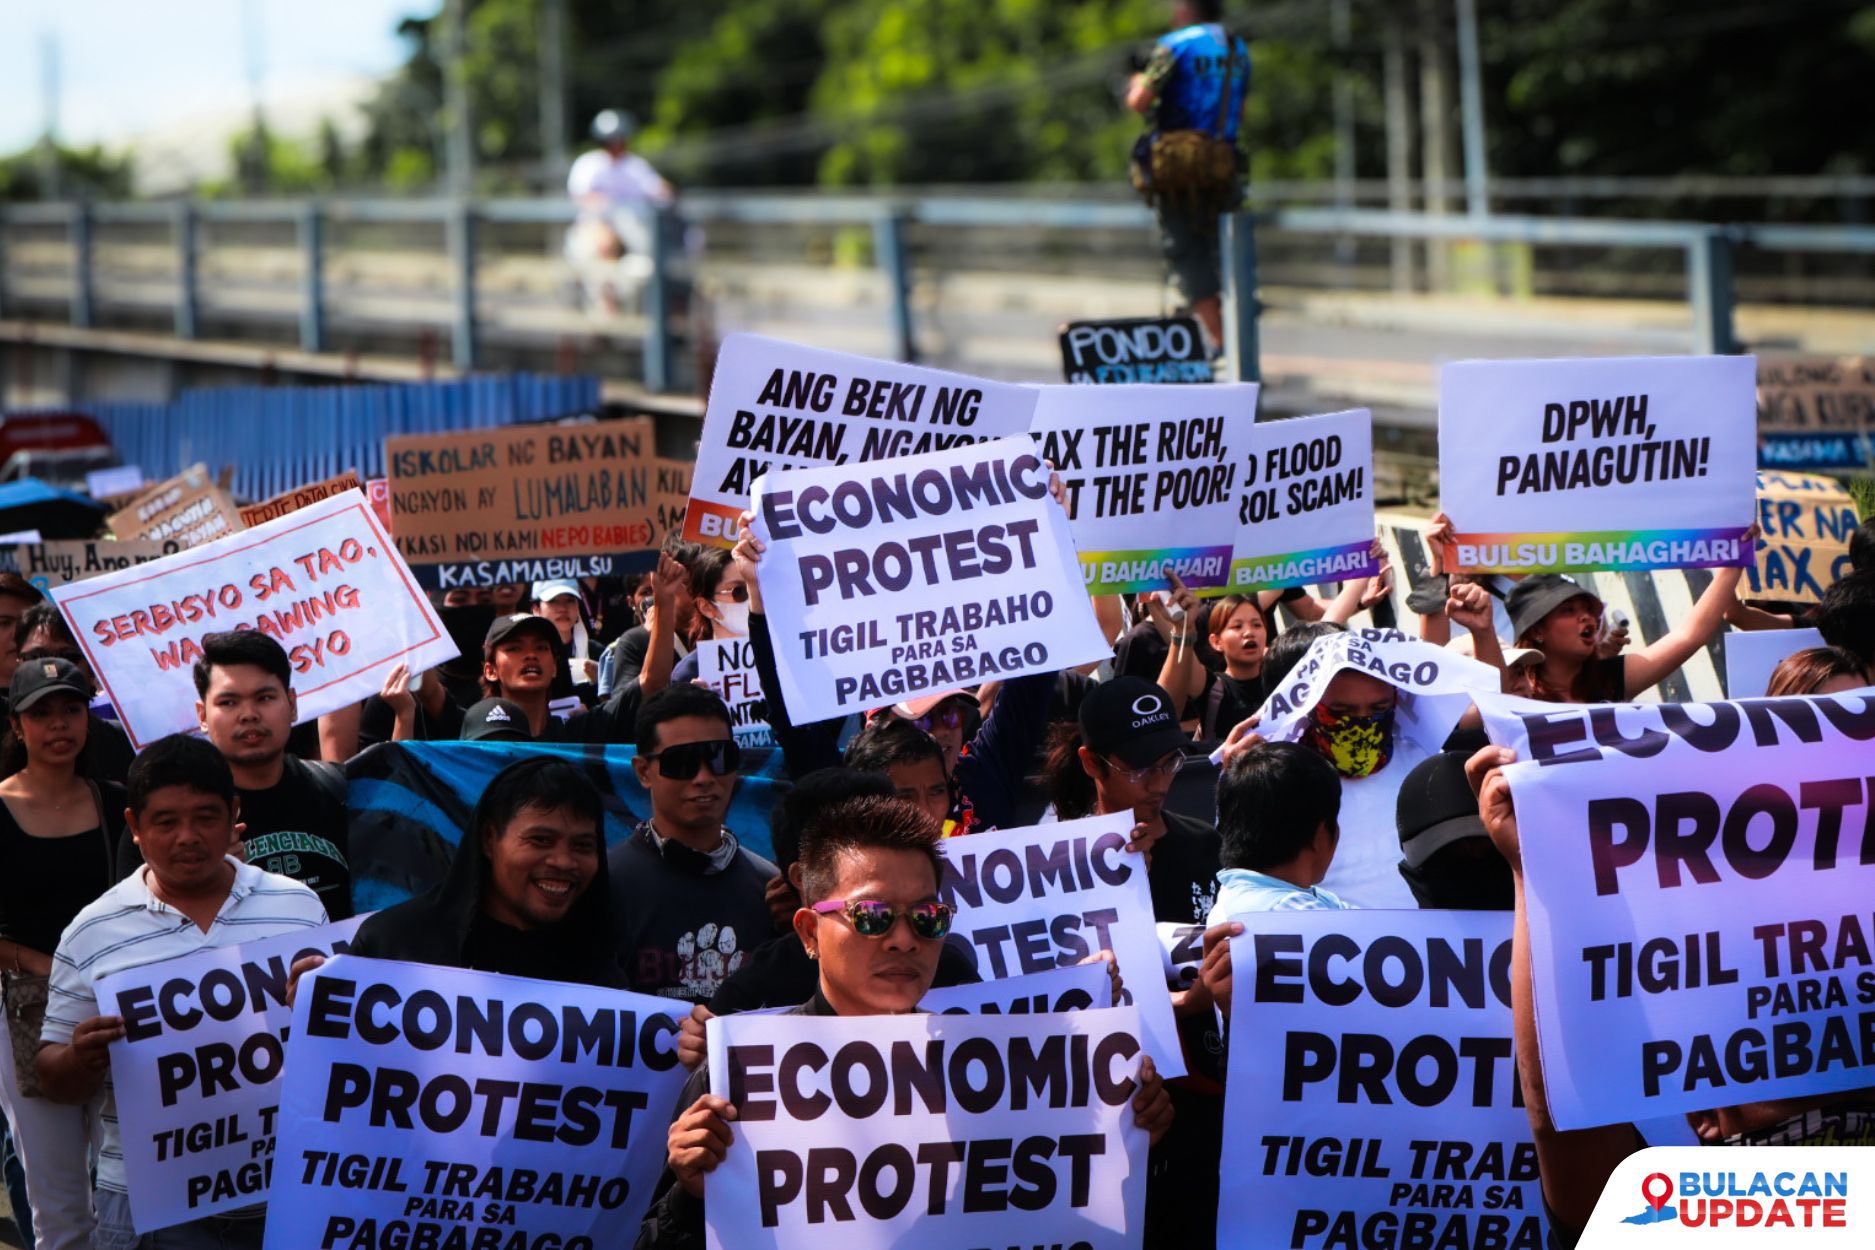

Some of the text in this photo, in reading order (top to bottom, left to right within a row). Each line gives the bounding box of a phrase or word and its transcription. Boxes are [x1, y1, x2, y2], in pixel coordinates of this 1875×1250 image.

[1068, 324, 1192, 367] PONDO
[757, 368, 983, 427] ANG BEKI NG
[1542, 395, 1656, 440] DPWH,
[393, 444, 497, 479] ISKOLAR
[547, 432, 641, 464] BAYAN
[726, 410, 1000, 467] BAYAN, NGAY
[1093, 422, 1150, 468] THE
[1156, 416, 1228, 463] RICH,
[1265, 435, 1343, 483] FLOOD
[1093, 472, 1149, 518] THE
[1153, 462, 1237, 513] POOR!
[1286, 466, 1364, 515] SCAM!
[1496, 437, 1710, 496] PANAGUTIN!
[393, 487, 467, 515] NGAYON
[477, 487, 497, 510] AY
[513, 466, 647, 521] LUMALABAN
[761, 454, 1047, 541] ECONOMIC
[456, 531, 488, 553] NDI
[494, 530, 538, 551] KAMI
[541, 527, 589, 549] NEPO
[798, 518, 1039, 606] PROTEST
[1457, 539, 1739, 567] BULSU BAHAGHARI
[438, 556, 613, 590] KASAMABULSU
[1100, 555, 1224, 584] BAHAGHARI
[1235, 550, 1368, 586] BAHAGHARI
[93, 583, 243, 646] SERBISYO
[250, 566, 296, 600] SA
[799, 590, 1054, 660] TIGIL TRABAHO
[835, 641, 1048, 706] PAGBABAGO
[891, 633, 978, 664] PARA SA
[1132, 712, 1170, 728] OAKLEY
[938, 832, 1133, 909] NOMIC
[1582, 913, 1875, 1002] TIGIL TRA
[307, 975, 681, 1072] ECONOMIC
[1747, 975, 1849, 1020] PARA
[158, 1027, 291, 1107] PRO
[727, 1032, 1141, 1122] ECONOMIC
[1282, 1031, 1527, 1108] PROT
[323, 1062, 648, 1150] PROTEST
[153, 1113, 247, 1162] TIGIL
[1261, 1135, 1390, 1178] TIGIL
[188, 1159, 274, 1208] PAG
[302, 1150, 630, 1210] TIGIL TRABAHO
[756, 1133, 1106, 1228] PROTEST
[1389, 1183, 1524, 1210] PARA SA
[403, 1197, 516, 1225] PARA SA
[1290, 1209, 1545, 1250] PAGBABA
